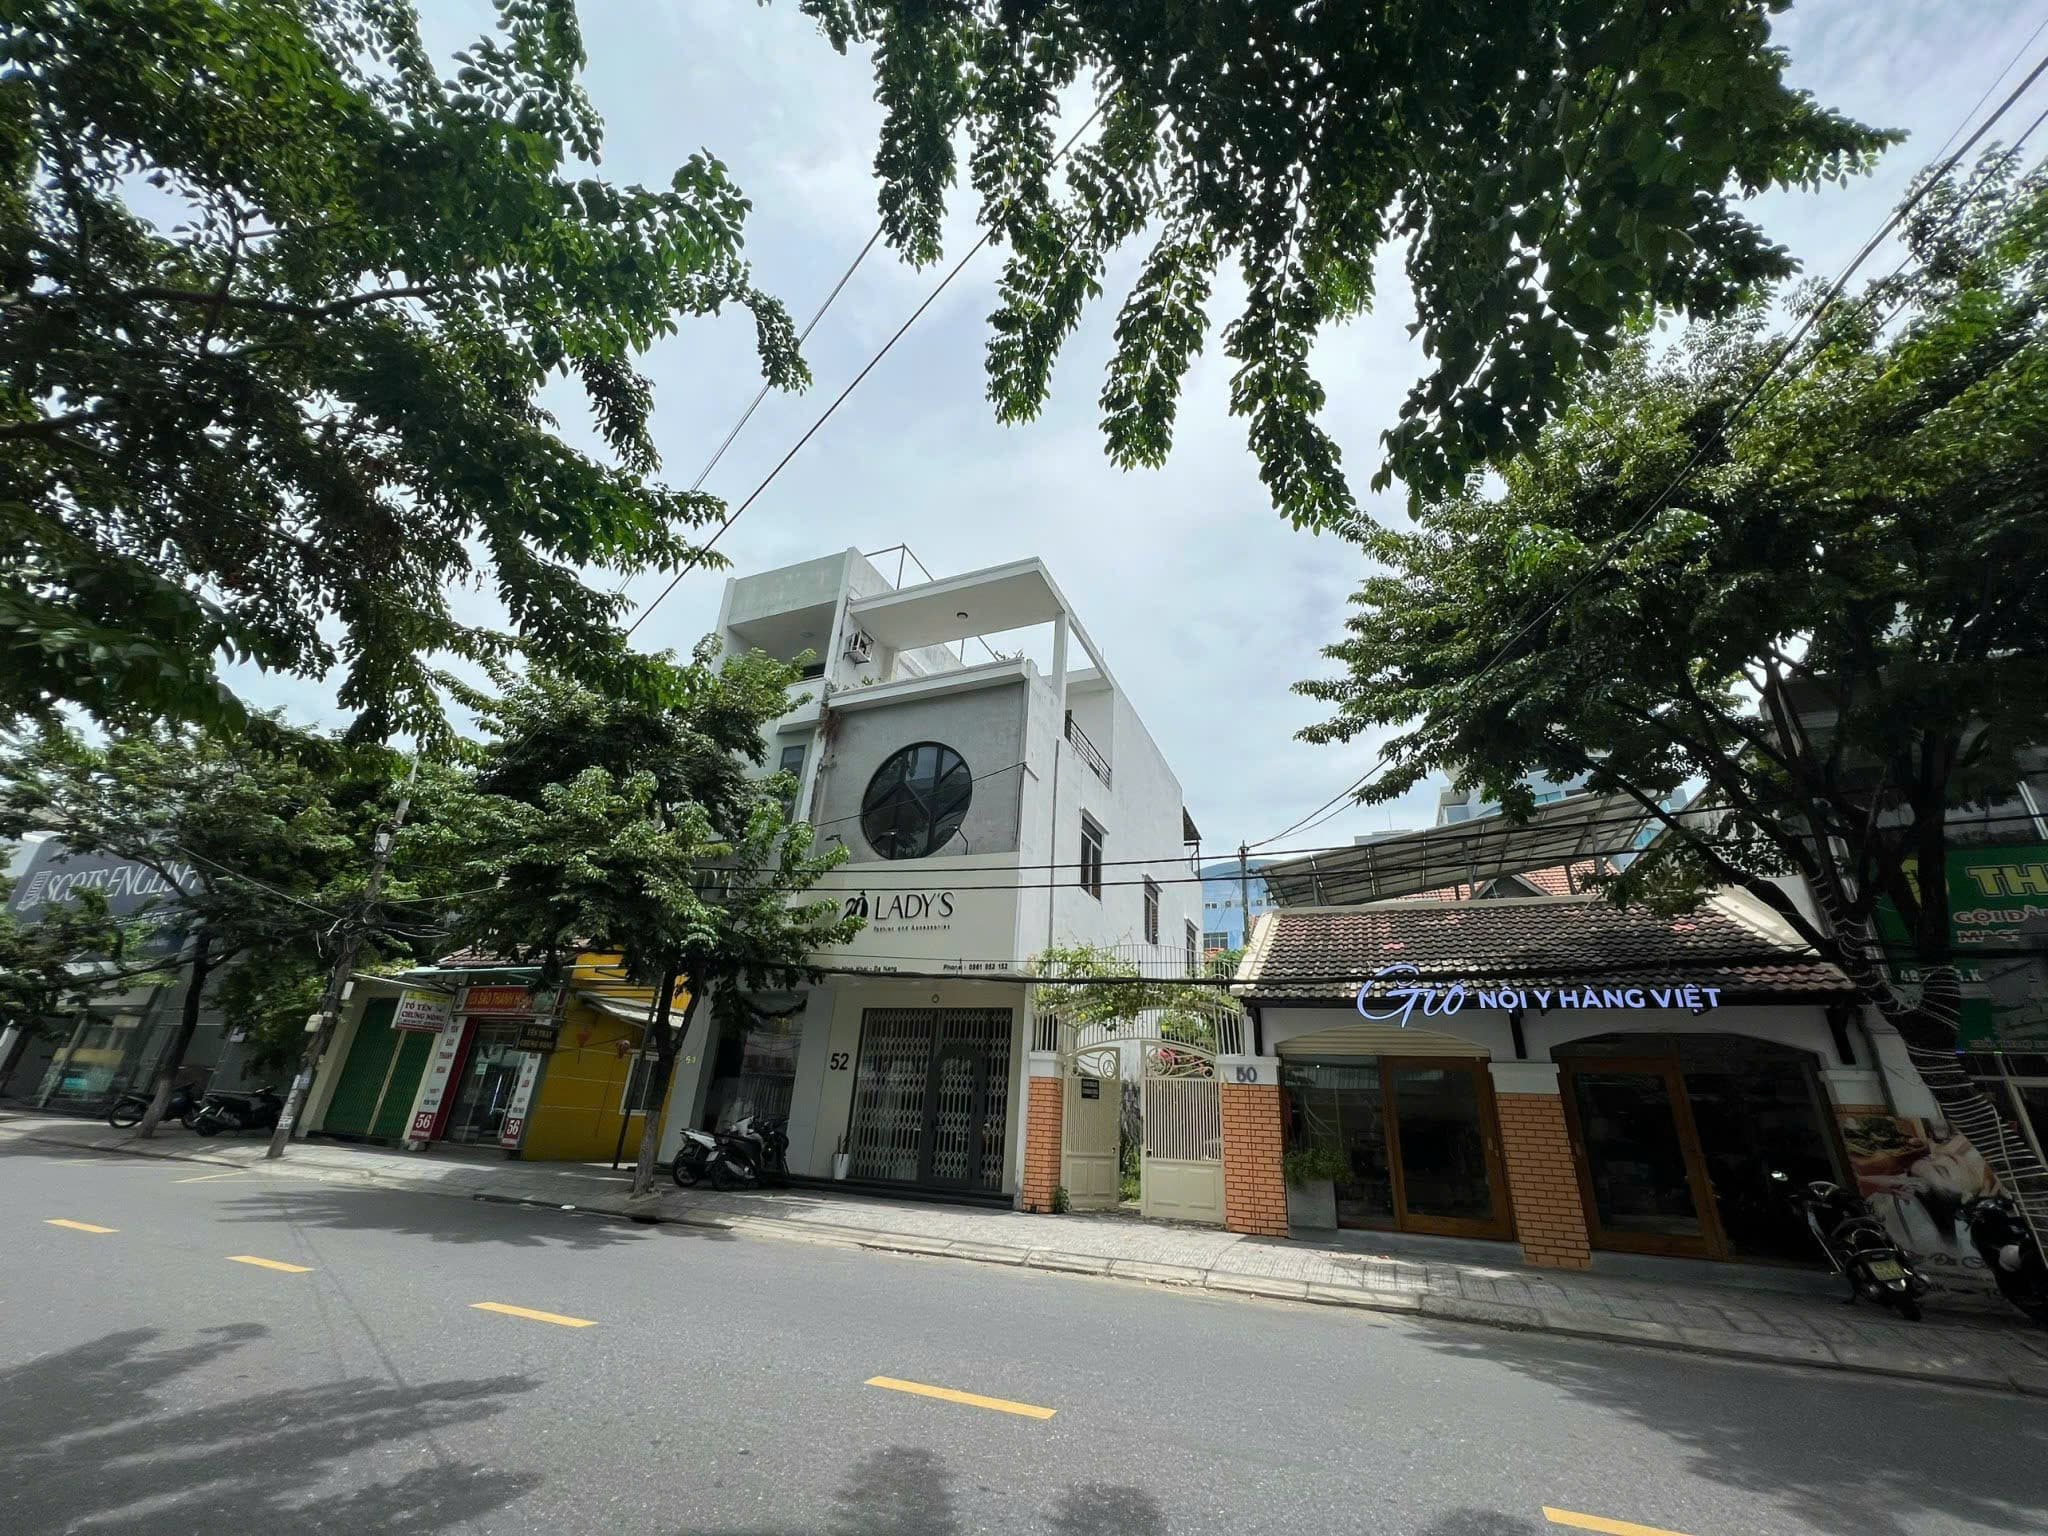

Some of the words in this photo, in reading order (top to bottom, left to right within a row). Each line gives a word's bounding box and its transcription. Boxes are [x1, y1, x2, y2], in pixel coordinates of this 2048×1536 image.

[106, 859, 199, 898] ENGLISH
[1965, 863, 2048, 897] TH
[874, 891, 955, 921] LADY'S
[1478, 986, 1527, 1013] NỘI
[1559, 984, 1647, 1010] HÀNG
[1650, 983, 1722, 1013] VIỆT
[830, 1052, 850, 1071] 52
[1236, 1066, 1258, 1083] 50
[415, 1113, 432, 1130] 56
[507, 1119, 521, 1135] 56
